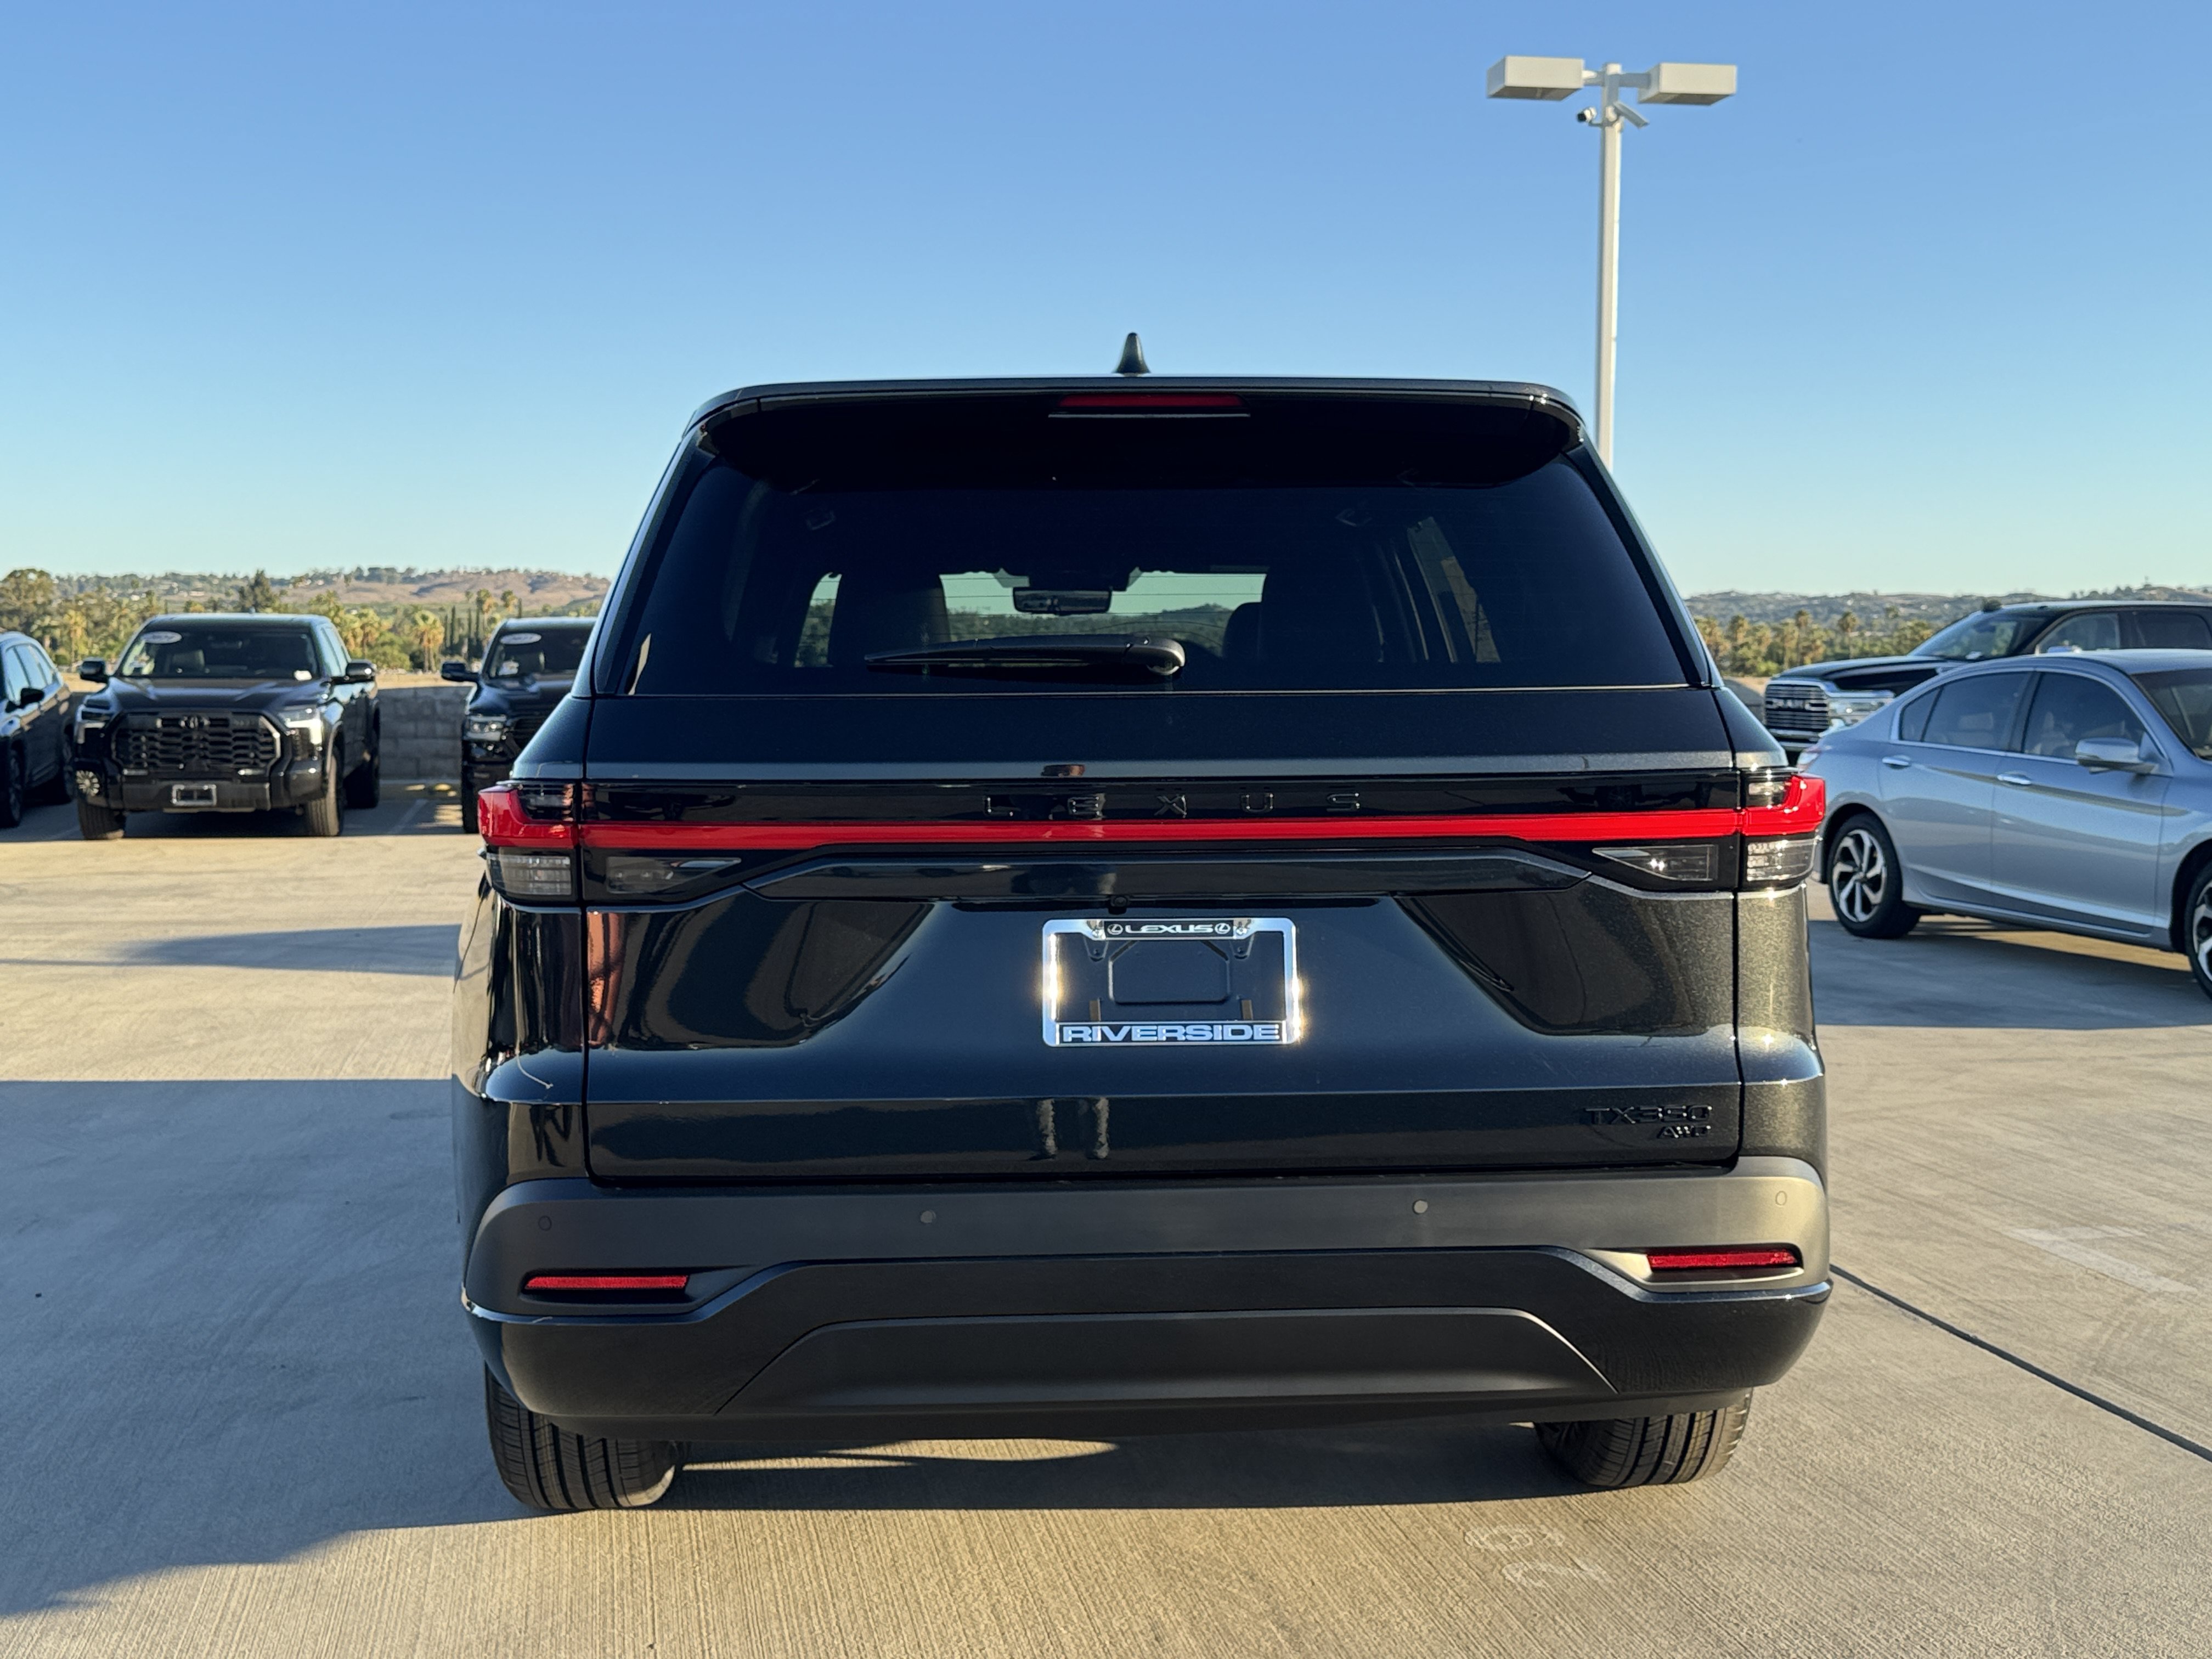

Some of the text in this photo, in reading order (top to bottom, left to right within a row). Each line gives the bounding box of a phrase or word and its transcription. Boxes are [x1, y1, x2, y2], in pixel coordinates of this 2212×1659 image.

[983, 793, 1361, 817] LEXUS
[1125, 924, 1214, 933] LEXUS
[1063, 1024, 1280, 1042] RIVERSIDE
